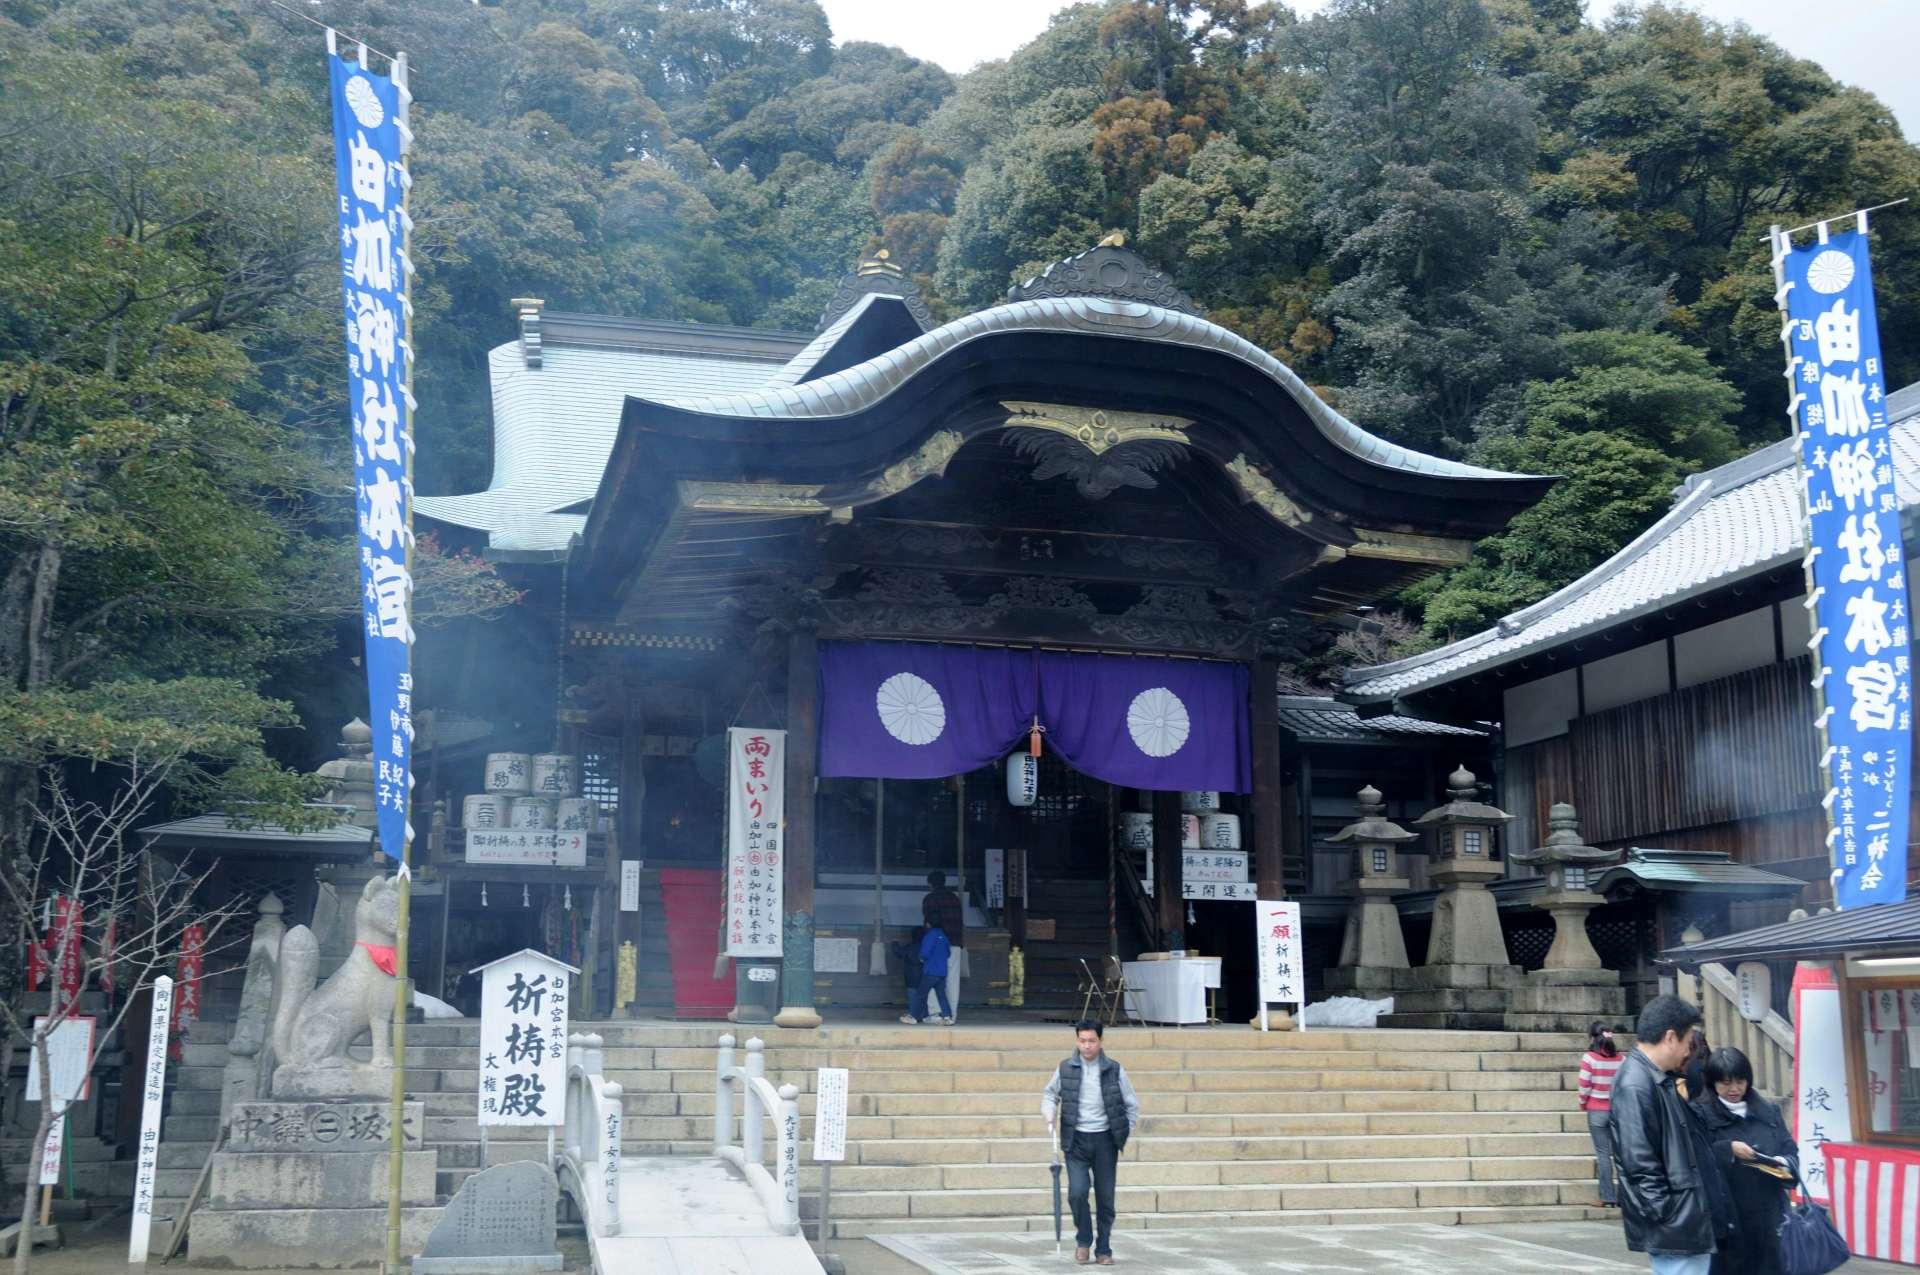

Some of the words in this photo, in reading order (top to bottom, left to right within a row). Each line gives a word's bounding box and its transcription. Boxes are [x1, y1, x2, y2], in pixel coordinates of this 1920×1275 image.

[744, 736, 771, 819] 両まいり
[483, 1052, 499, 1114] 大権現
[499, 972, 547, 1118] 祈祷殿
